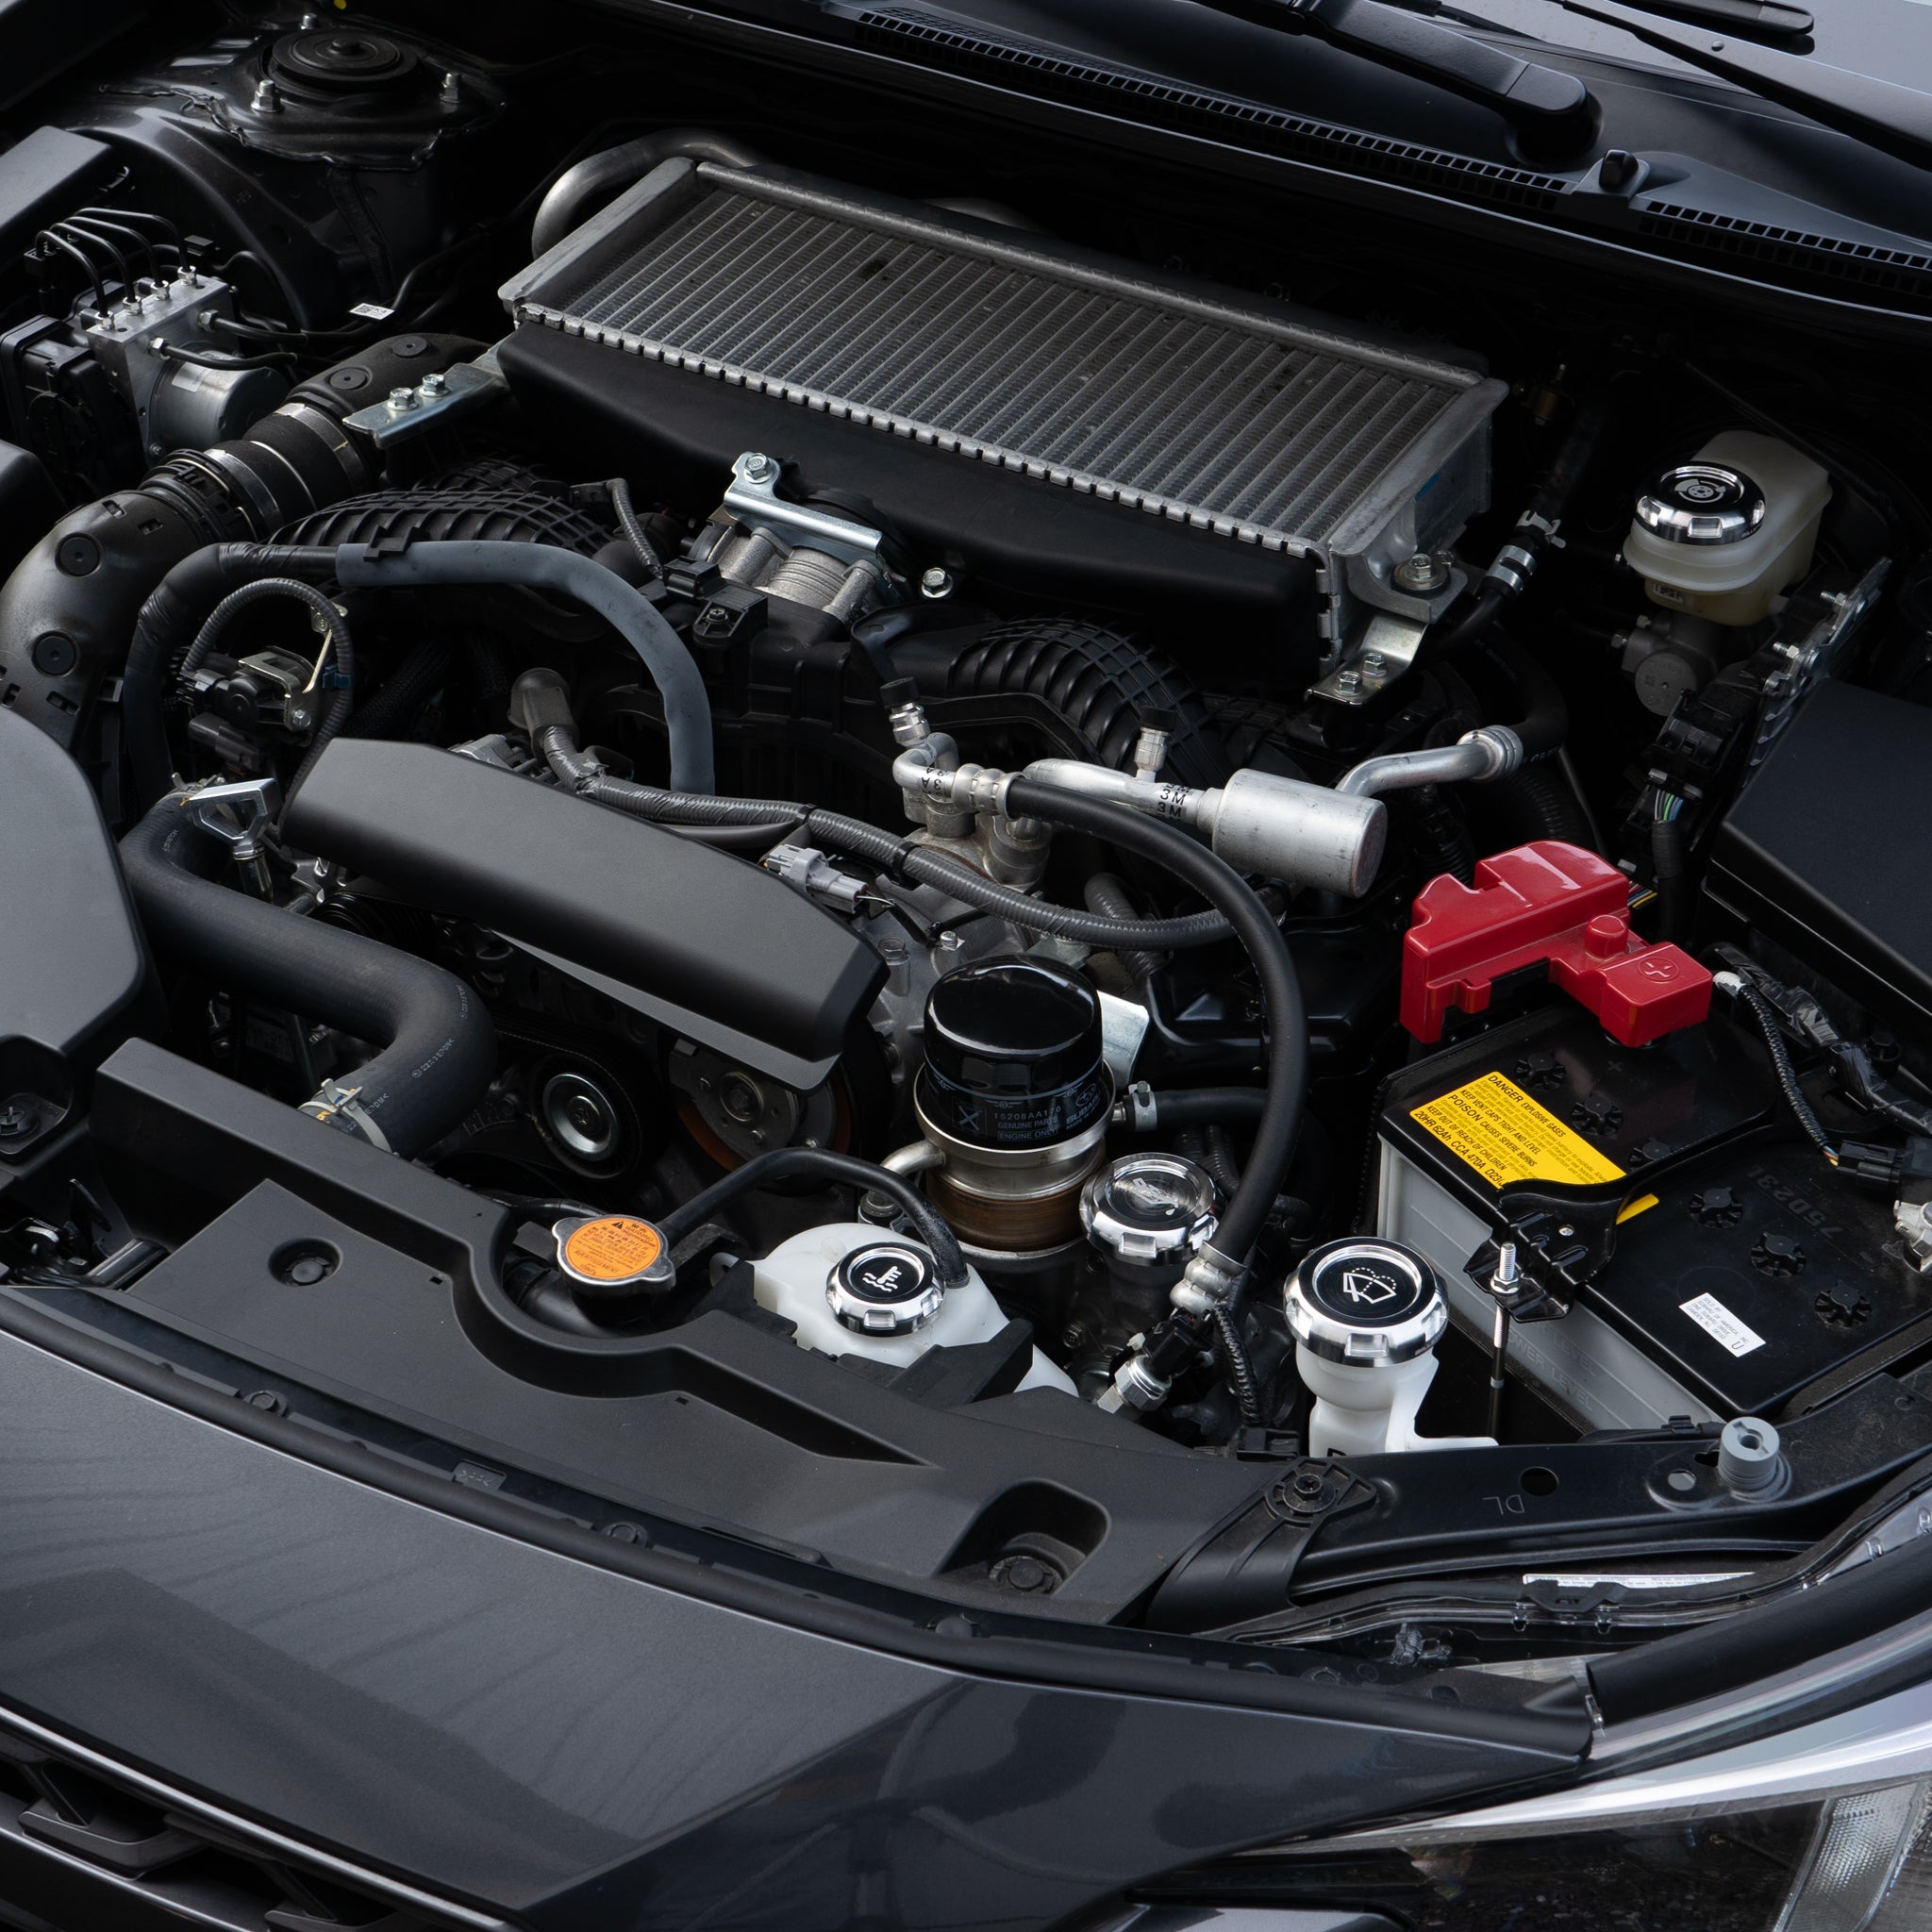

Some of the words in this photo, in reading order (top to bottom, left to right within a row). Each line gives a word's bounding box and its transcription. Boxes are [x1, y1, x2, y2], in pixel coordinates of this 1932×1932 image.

[998, 1121, 1032, 1130] GENUINE
[999, 1132, 1032, 1141] ENGINE
[1447, 1094, 1484, 1121] POISON
[1479, 1121, 1503, 1138] CAUSES
[1498, 1136, 1521, 1152] SEVERE
[1517, 1151, 1538, 1166] BURNS
[1458, 1089, 1475, 1101] KEEP
[1471, 1099, 1489, 1110] VENT
[1483, 1108, 1502, 1122] CAPS
[1497, 1120, 1516, 1133] TIGHT
[1511, 1131, 1527, 1142] AND
[1523, 1140, 1542, 1155] LEVEL
[1487, 1074, 1524, 1102] DANGER
[1520, 1102, 1550, 1124] EXPLOSIVE
[1545, 1122, 1567, 1137] GASES
[1413, 1110, 1437, 1127] 20HR
[1430, 1124, 1454, 1141] 62Ah
[1449, 1140, 1471, 1155] CCA
[1465, 1152, 1488, 1169] 470A
[1425, 1105, 1442, 1117] KEEP
[1438, 1115, 1452, 1124] OUT
[1455, 1129, 1476, 1144] REACH
[1478, 1148, 1507, 1170] CHILDREN
[1747, 1164, 1843, 1238] 75D23L
[1508, 1334, 1545, 1369] OWER
[1552, 1367, 1593, 1412] LEVEL
[1731, 1341, 1745, 1350] U
[1482, 1494, 1524, 1515] DL
